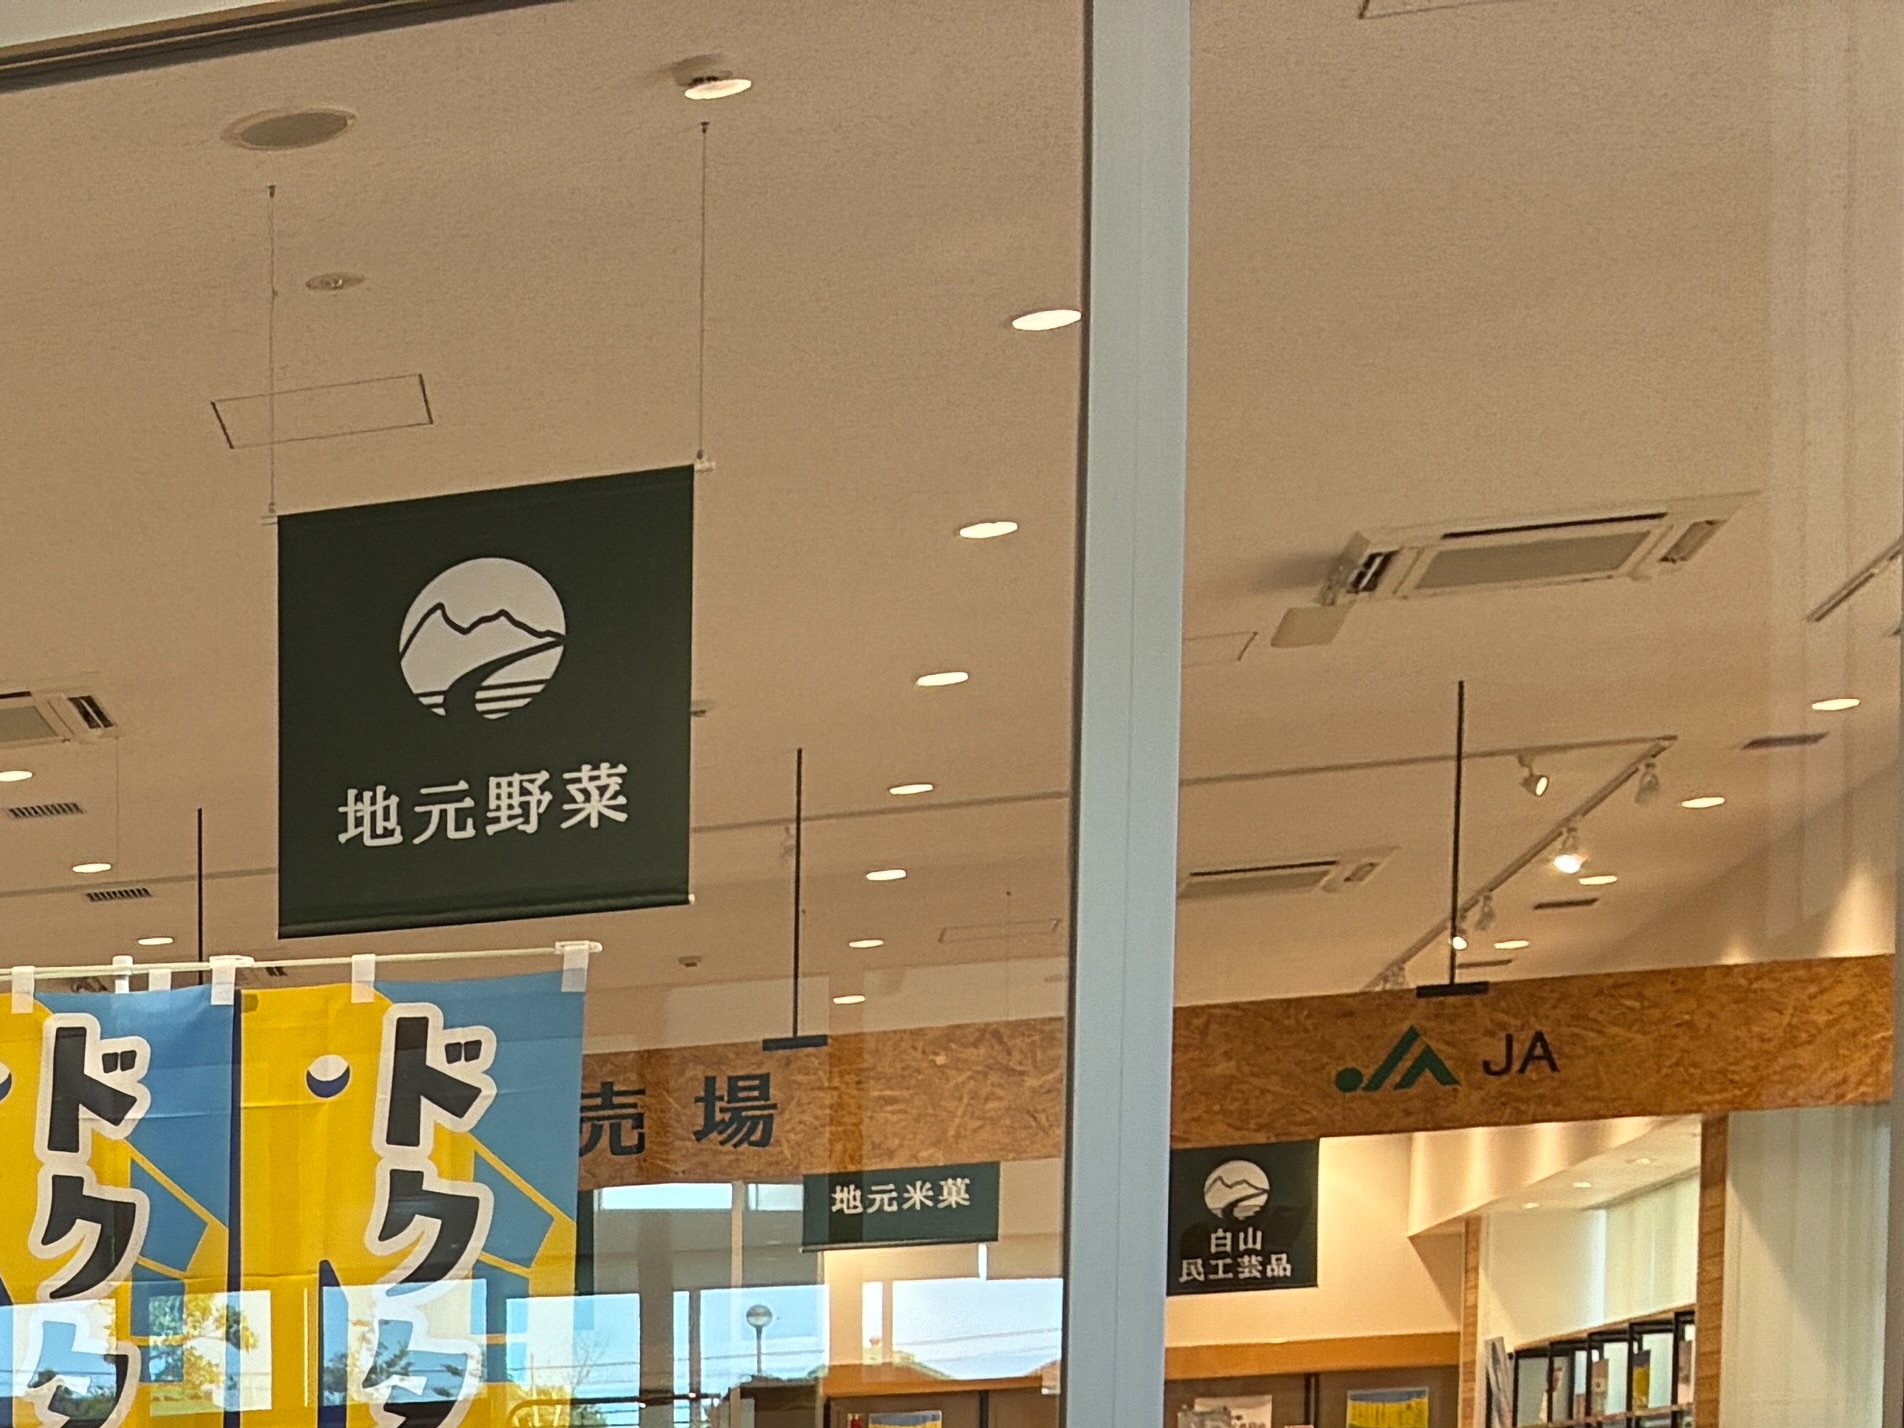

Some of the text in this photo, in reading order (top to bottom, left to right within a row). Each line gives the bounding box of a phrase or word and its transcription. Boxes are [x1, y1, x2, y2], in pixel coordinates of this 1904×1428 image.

[338, 762, 628, 847] 地元野菜
[1482, 1031, 1559, 1076] JA
[831, 1177, 970, 1216] 地元米菓
[1210, 1227, 1262, 1253] 白山
[1179, 1253, 1291, 1282] 民工芸品
